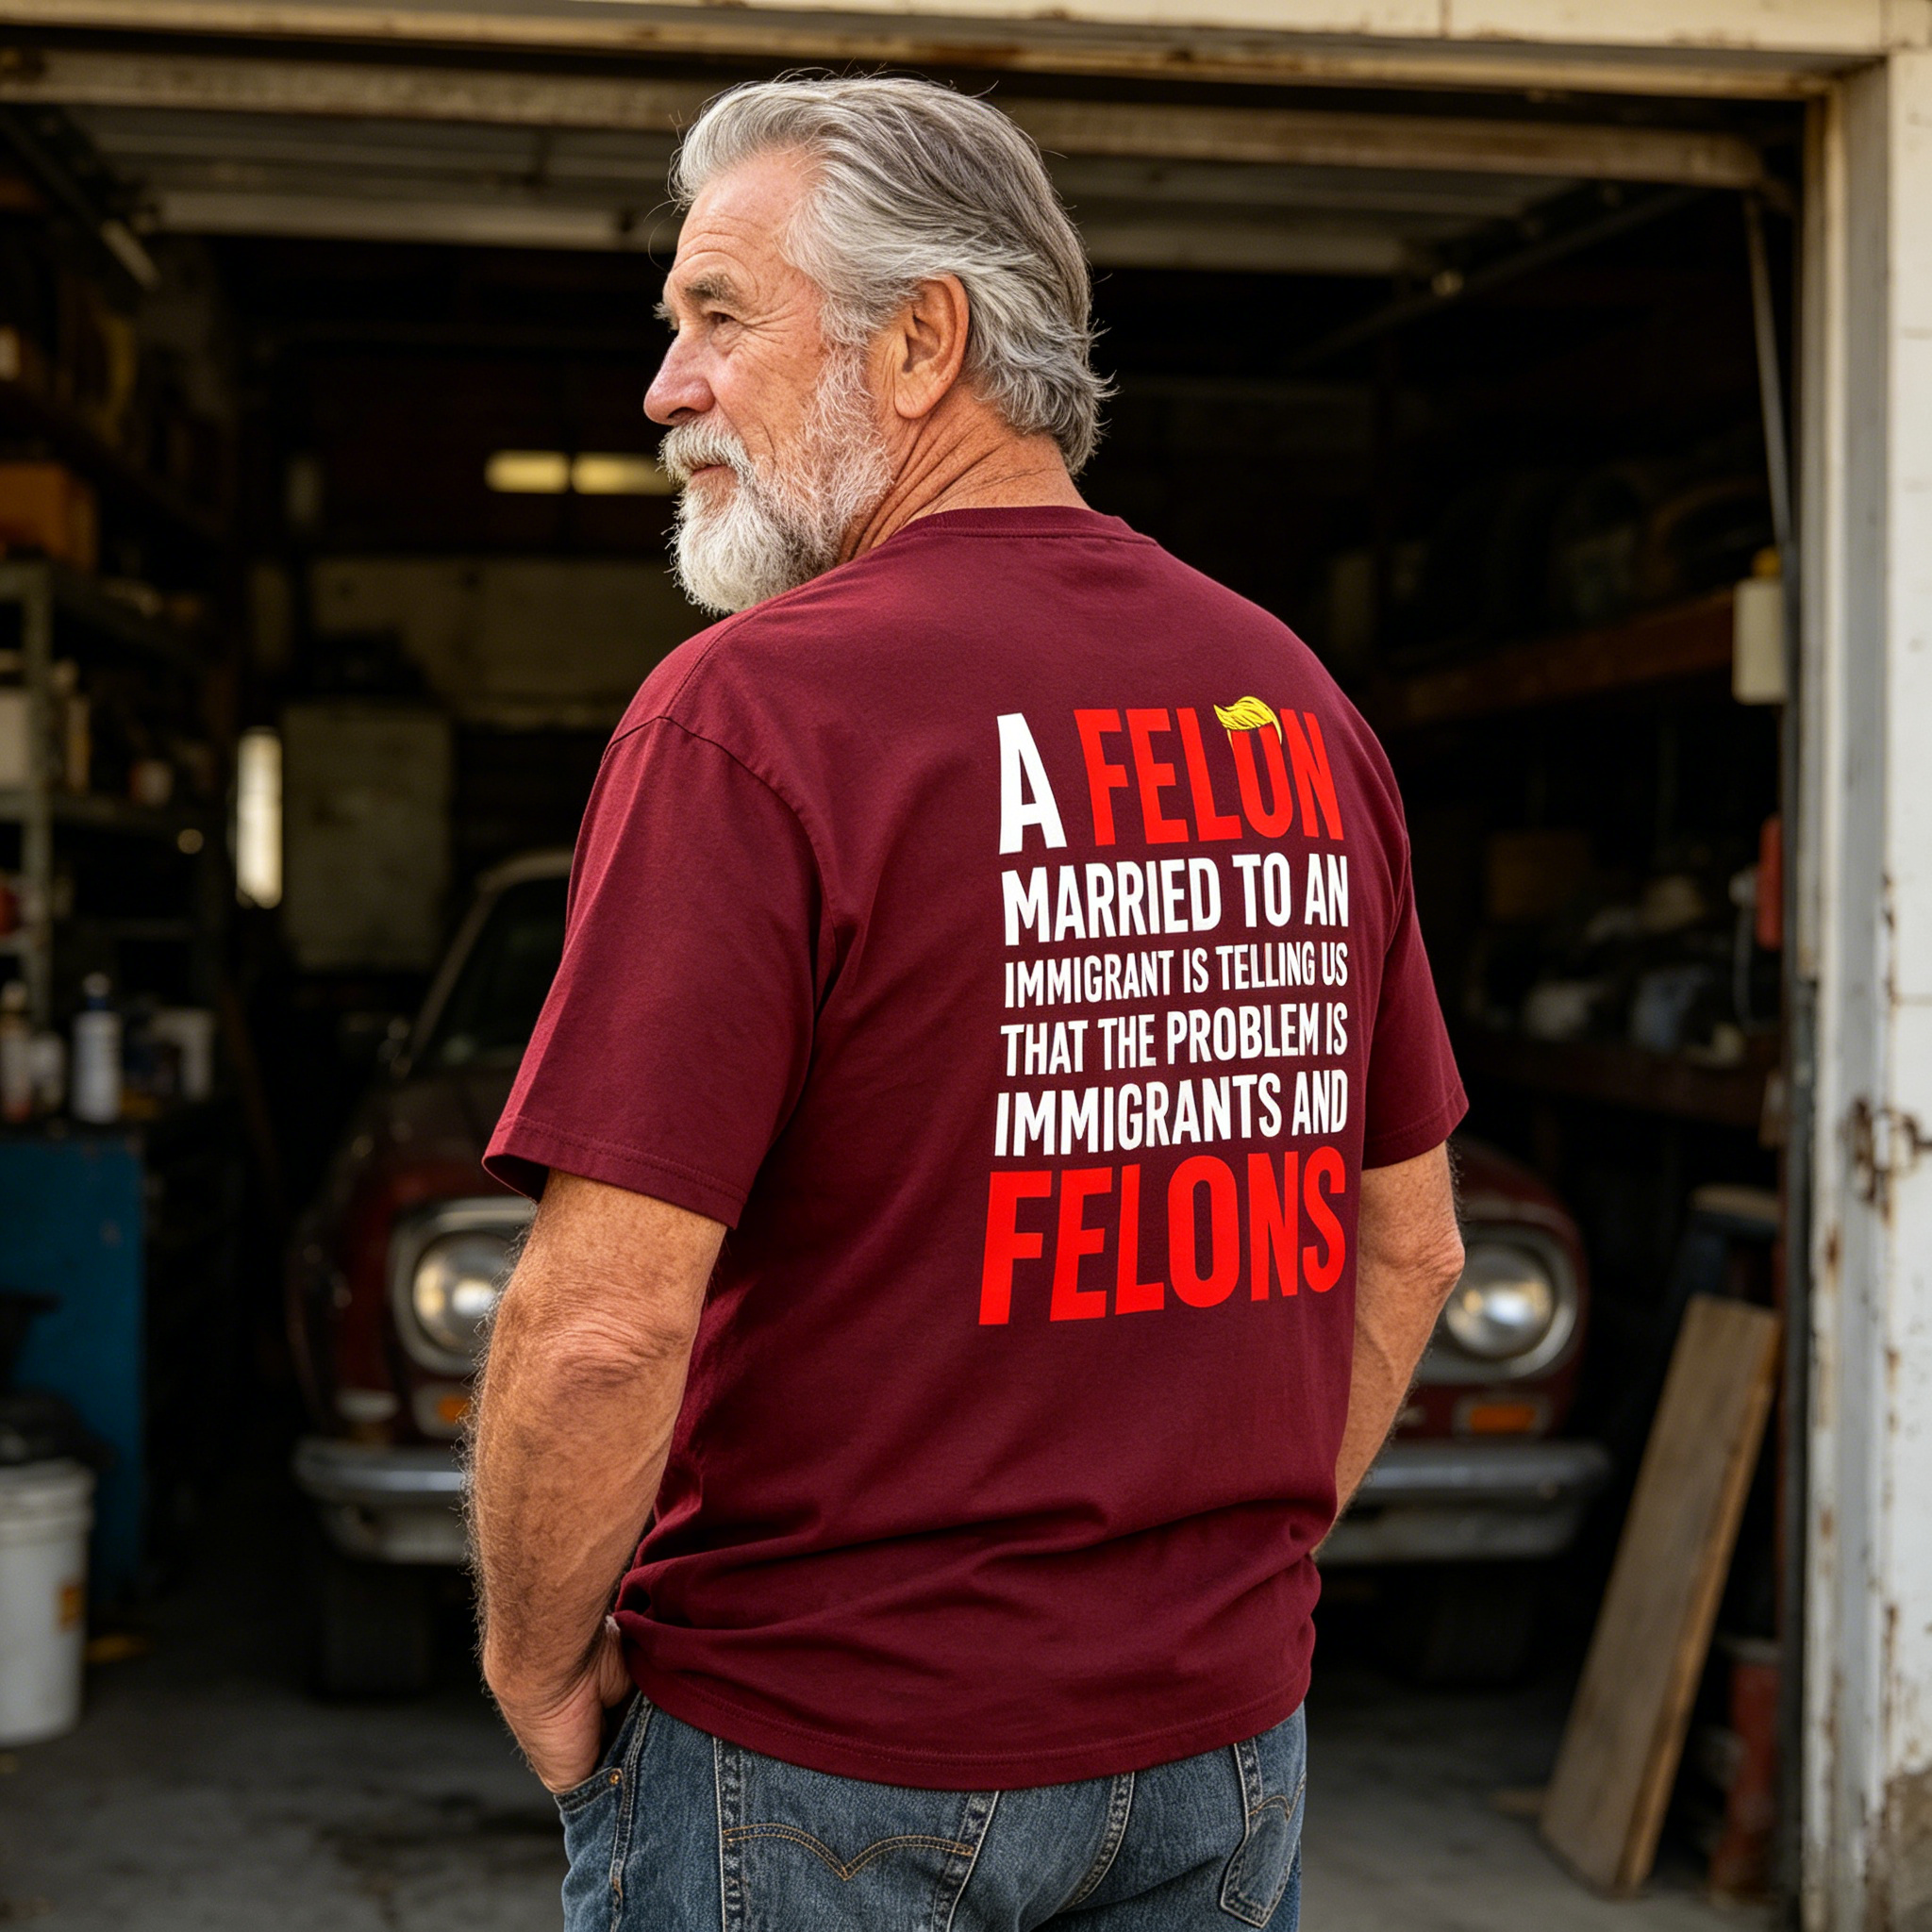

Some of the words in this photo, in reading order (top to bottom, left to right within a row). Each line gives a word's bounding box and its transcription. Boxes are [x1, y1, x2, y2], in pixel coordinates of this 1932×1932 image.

[997, 712, 1067, 855] A
[1074, 707, 1344, 846] FELON
[1001, 858, 1222, 945] MARRIED
[1232, 852, 1292, 927] TO
[1304, 853, 1349, 927] AN
[1005, 950, 1174, 1008] IMMIGRANT
[1183, 947, 1208, 993] IS
[1215, 941, 1315, 991] TELLING
[1322, 942, 1348, 986] US
[1001, 1020, 1088, 1076] THAT
[1098, 1014, 1157, 1070] THE
[1167, 1002, 1319, 1065] PROBLEM
[1325, 1002, 1348, 1056] IS
[994, 1073, 1281, 1157] IMMIGRANTS
[1291, 1069, 1348, 1137] AND
[978, 1145, 1346, 1324] FELONS
